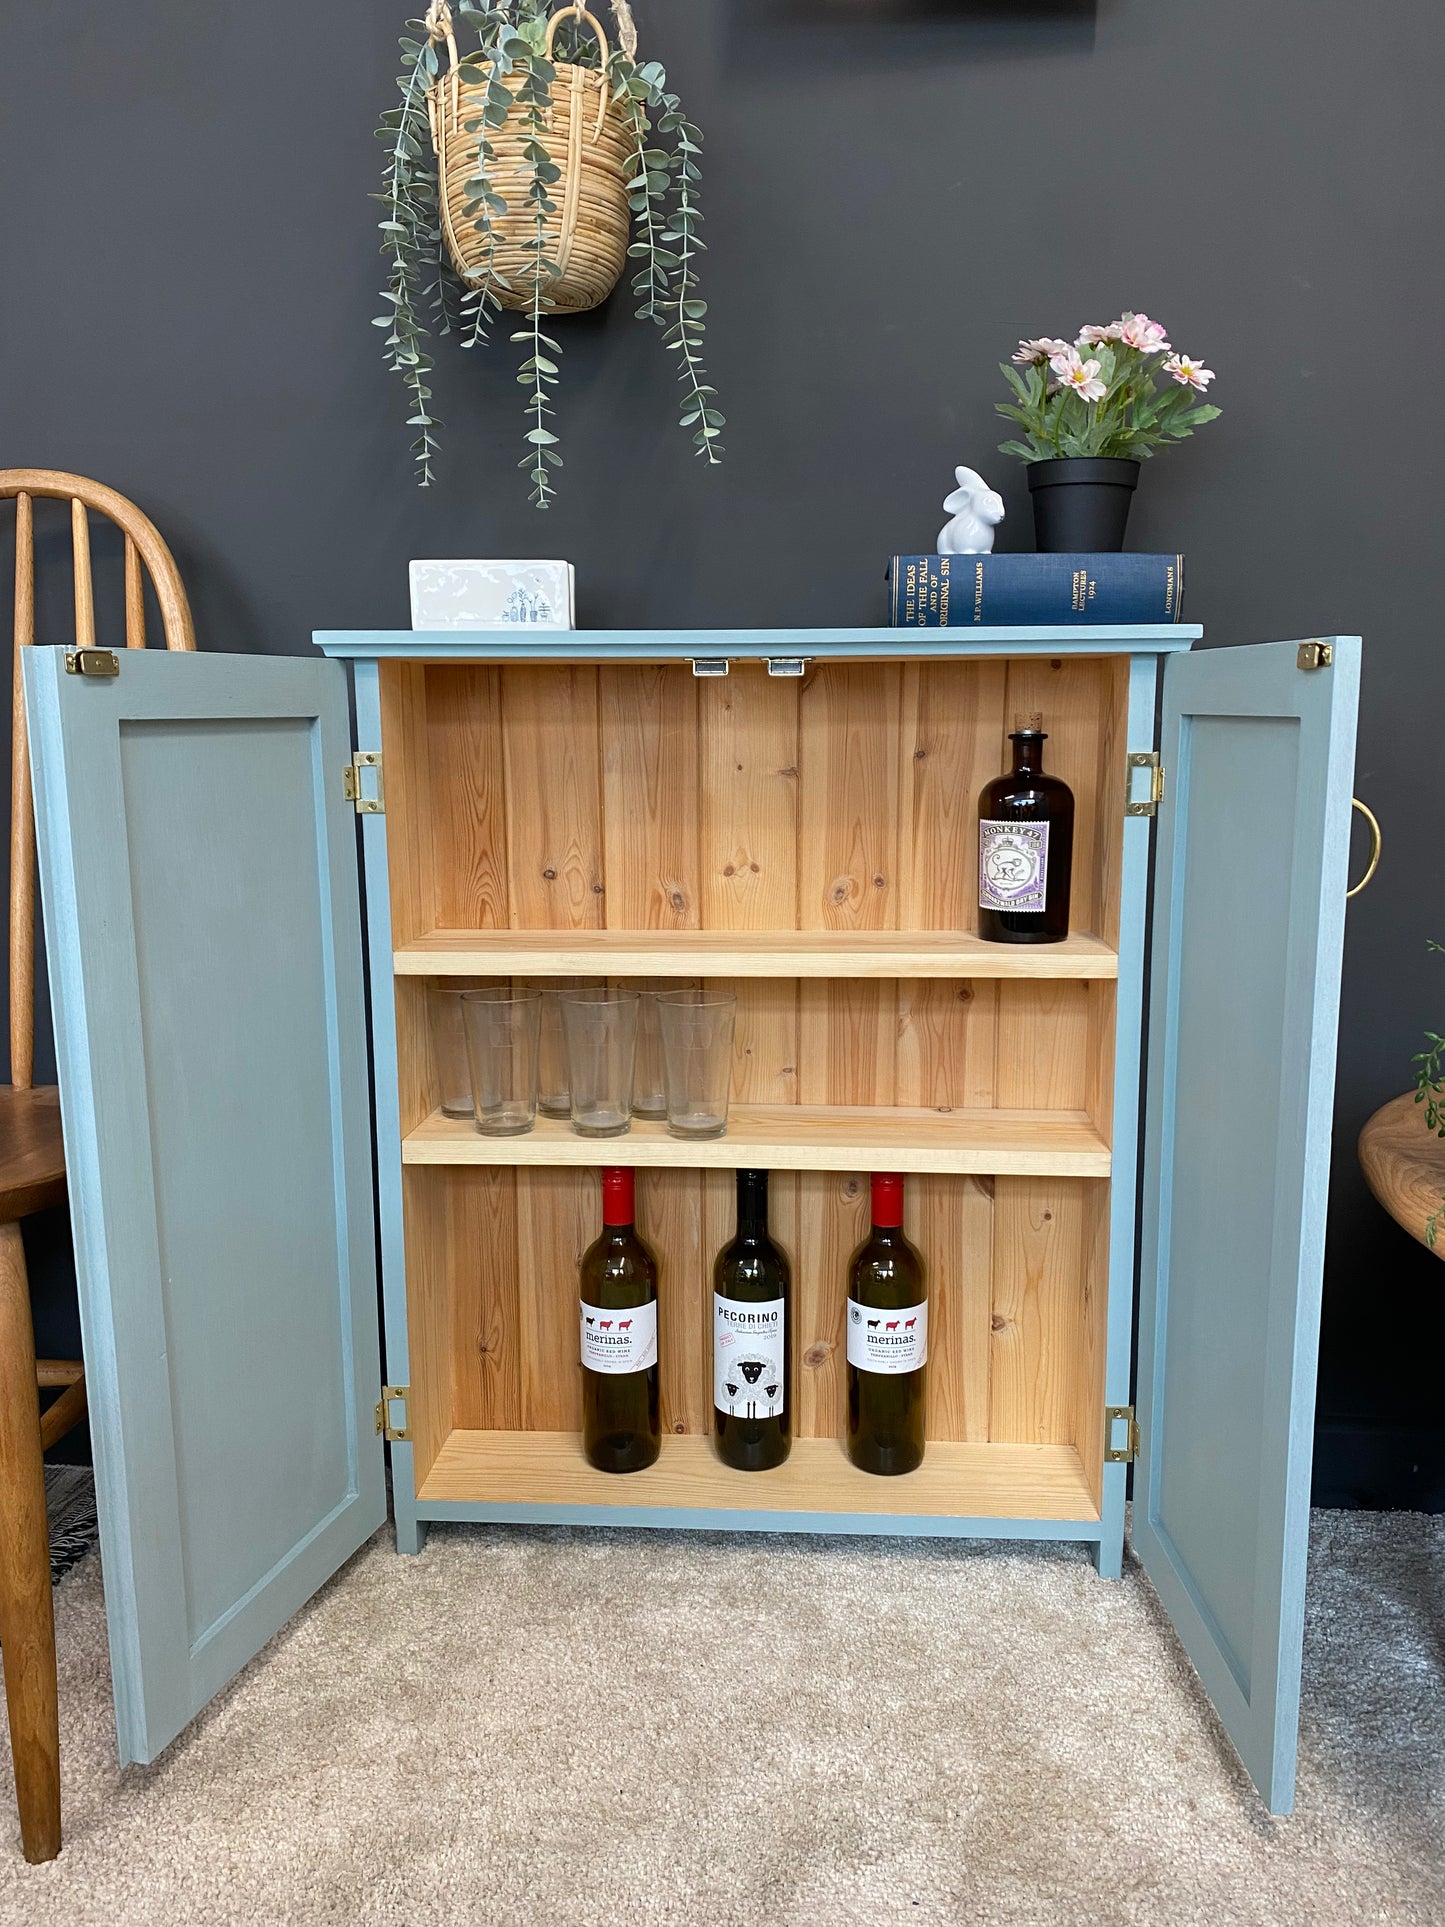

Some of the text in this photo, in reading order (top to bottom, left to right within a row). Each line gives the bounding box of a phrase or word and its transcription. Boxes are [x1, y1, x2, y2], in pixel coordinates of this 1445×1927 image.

[906, 565, 916, 622] THE IDEAS
[918, 558, 928, 626] OF THE FALL
[930, 574, 938, 588] OF
[940, 558, 950, 626] ORIGINAL SIN
[1078, 570, 1086, 611] LECTURES
[1088, 580, 1096, 599] 1924
[1164, 566, 1174, 614] LONGMANS
[984, 826, 1026, 836] MONKEY
[718, 1306, 778, 1323] PECORINO
